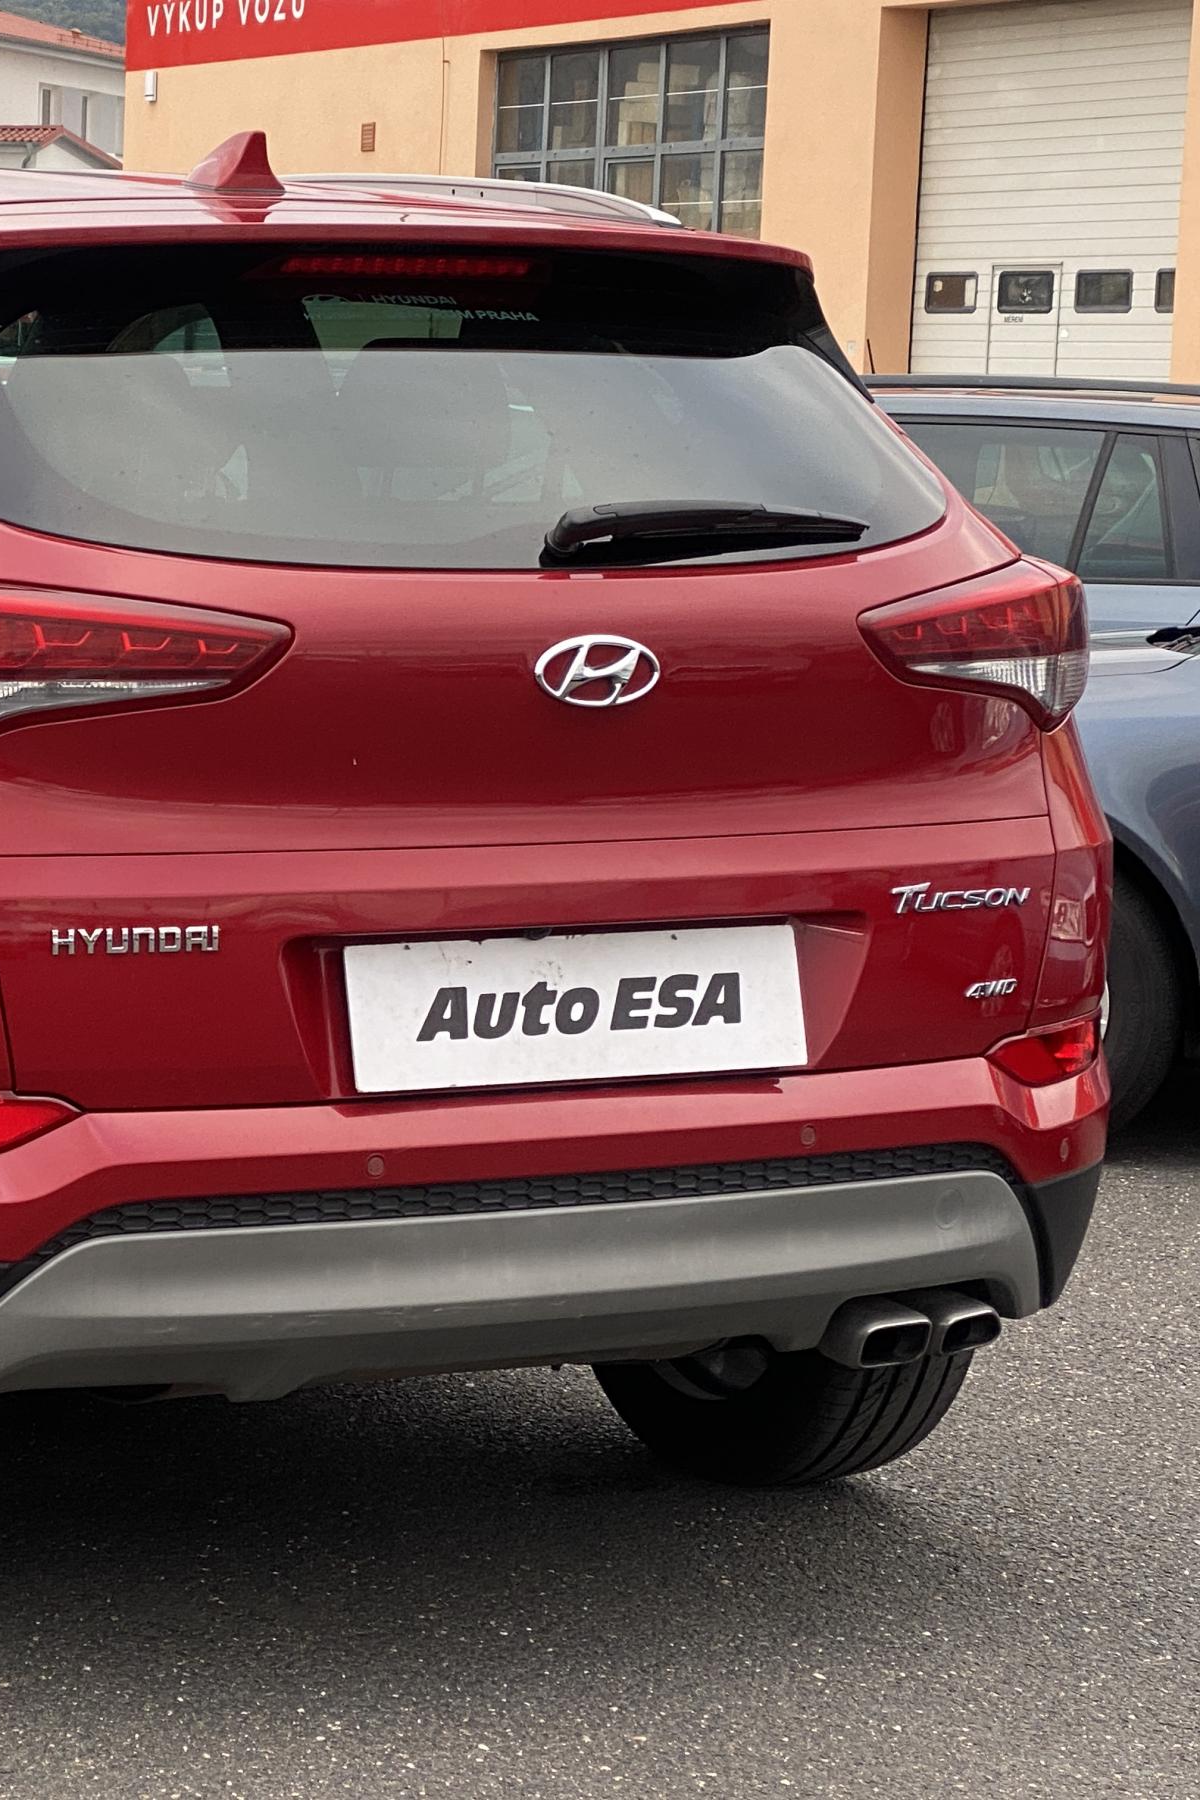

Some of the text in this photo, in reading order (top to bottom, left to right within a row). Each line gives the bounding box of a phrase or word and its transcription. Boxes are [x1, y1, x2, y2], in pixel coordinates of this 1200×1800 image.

[371, 294, 457, 306] HYUNDAI
[476, 309, 540, 322] PRAHA
[51, 925, 220, 956] HYUNDAI
[965, 977, 1018, 999] 4WD
[416, 972, 742, 1043] Auto ESA
